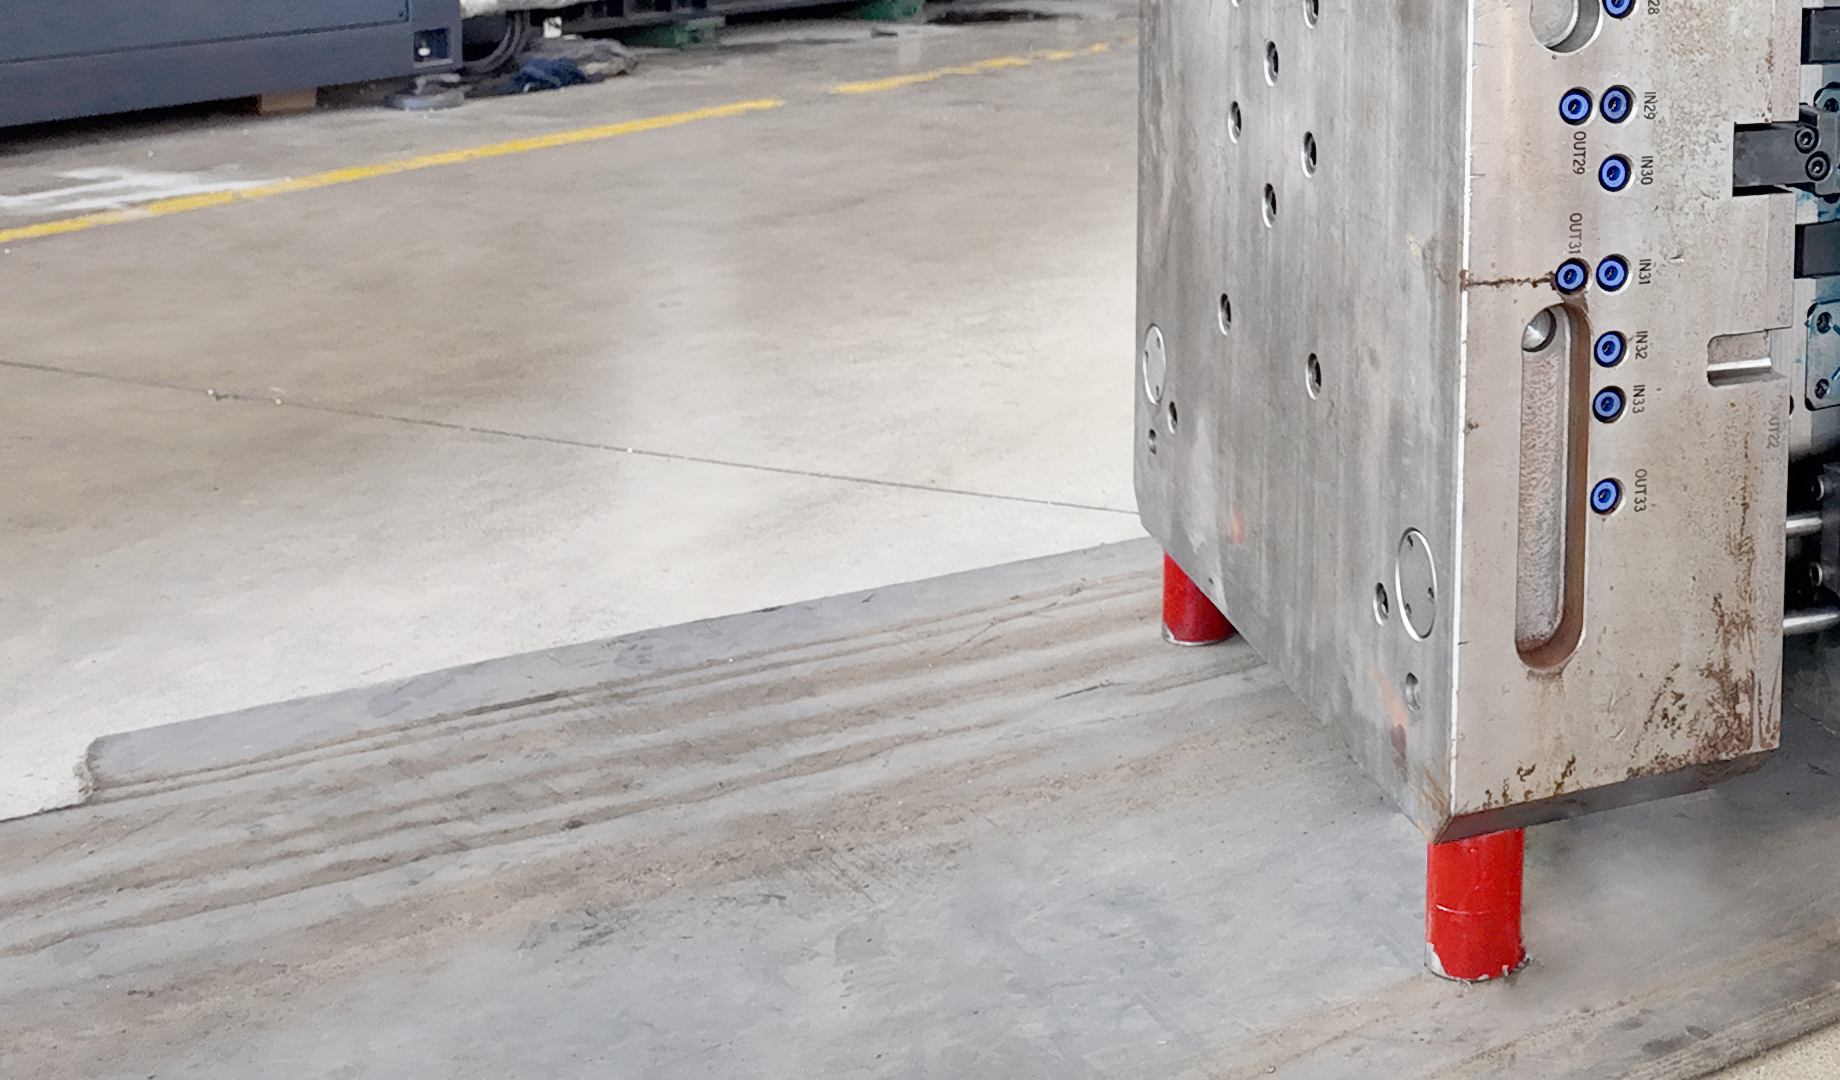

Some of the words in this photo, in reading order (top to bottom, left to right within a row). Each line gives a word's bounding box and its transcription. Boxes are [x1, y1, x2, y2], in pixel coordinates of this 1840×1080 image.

[1643, 91, 1656, 120] IN29
[1572, 130, 1586, 175] OUT29
[1641, 155, 1653, 185] IN30
[1569, 212, 1582, 254] OUT31
[1638, 258, 1651, 286] IN31
[1634, 330, 1648, 360] IN32
[1632, 384, 1646, 414] IN33
[1766, 408, 1780, 449] UT22
[1633, 468, 1647, 513] OUT33
